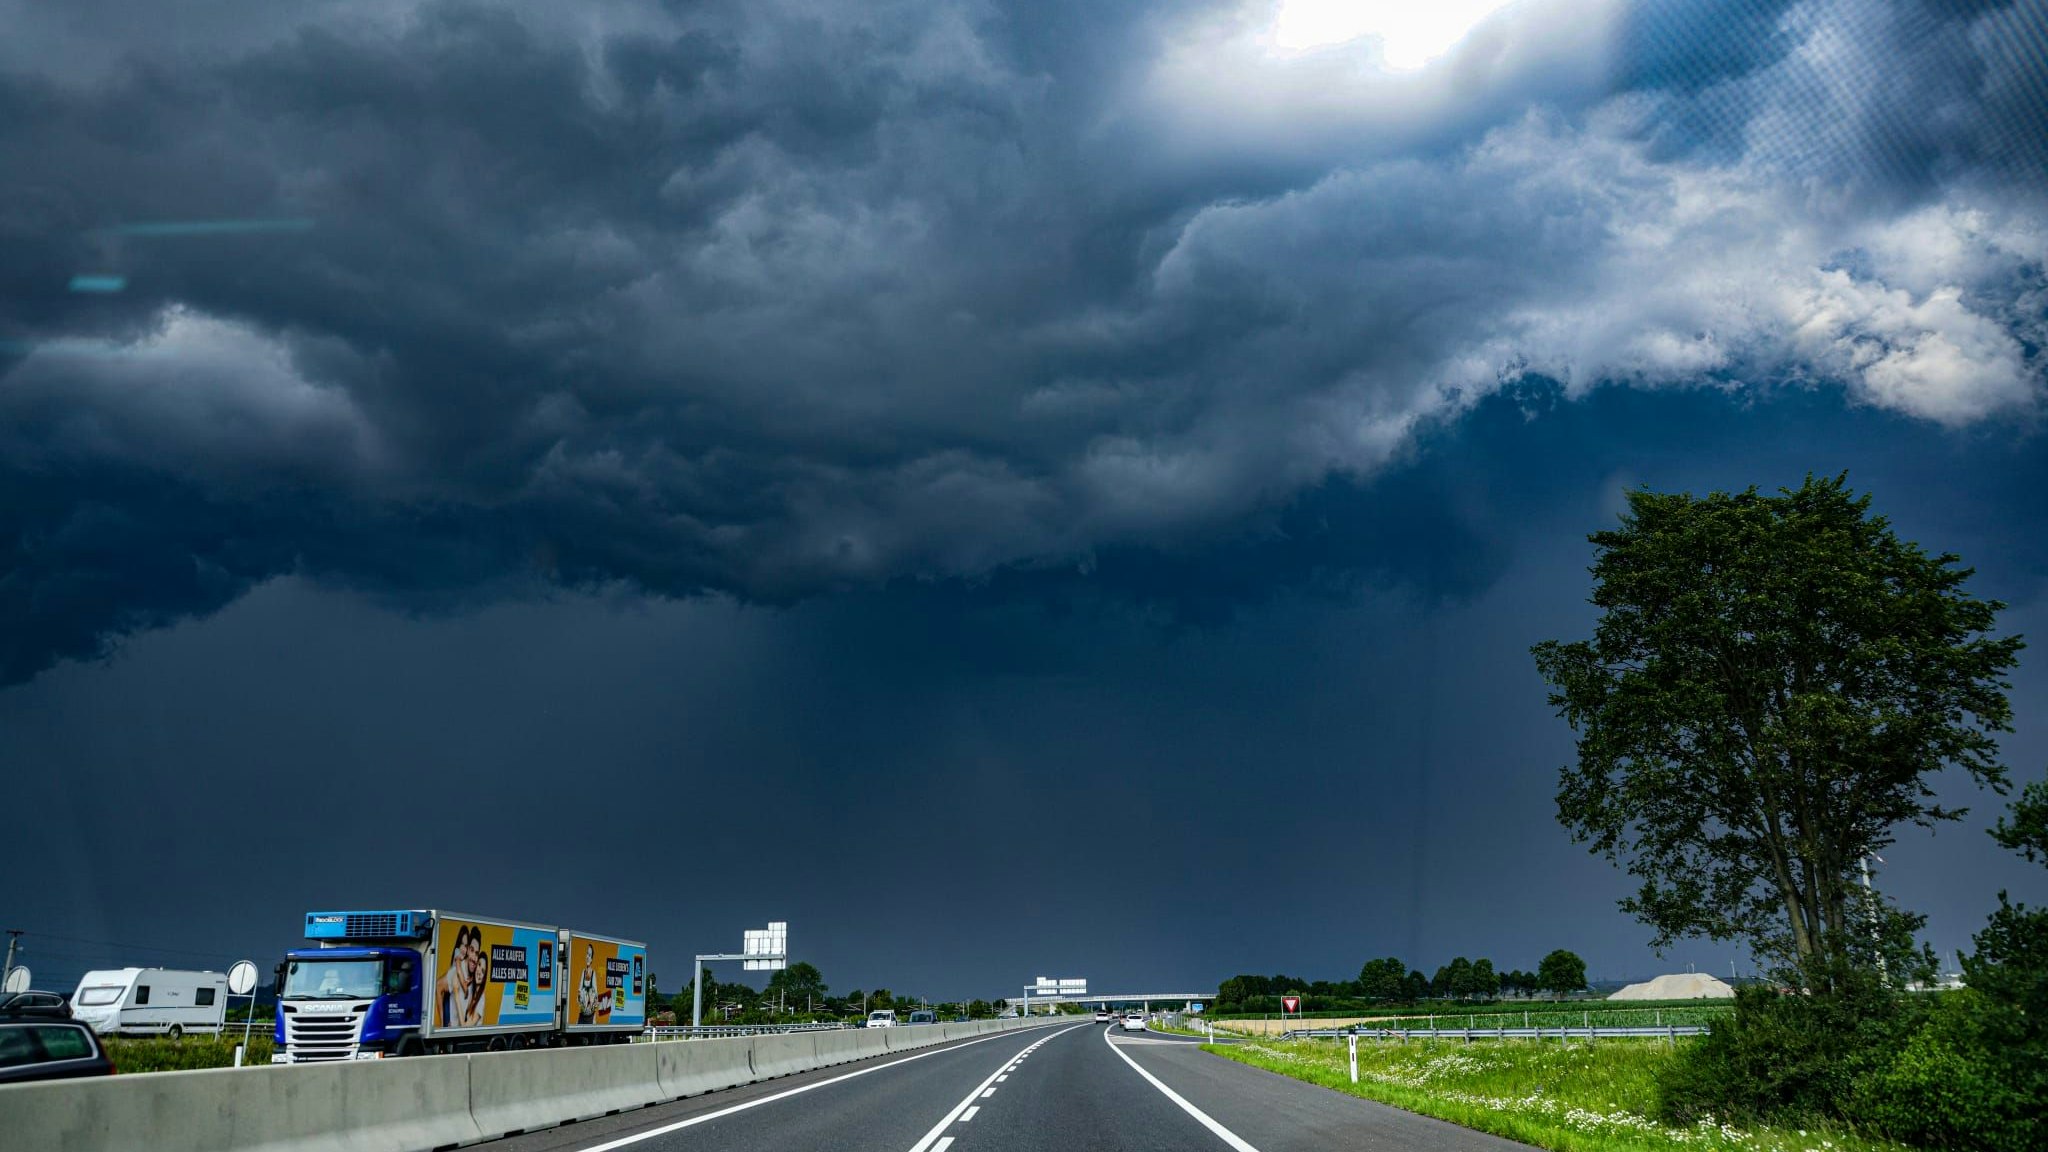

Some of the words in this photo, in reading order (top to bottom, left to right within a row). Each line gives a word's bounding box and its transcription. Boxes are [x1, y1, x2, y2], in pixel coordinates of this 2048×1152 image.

[492, 948, 504, 960] ALLE
[506, 949, 525, 962] KAUFEN
[491, 967, 507, 980] ALLES
[508, 968, 516, 980] EIN
[516, 968, 527, 980] ZUM
[304, 1004, 344, 1012] SCANIA
